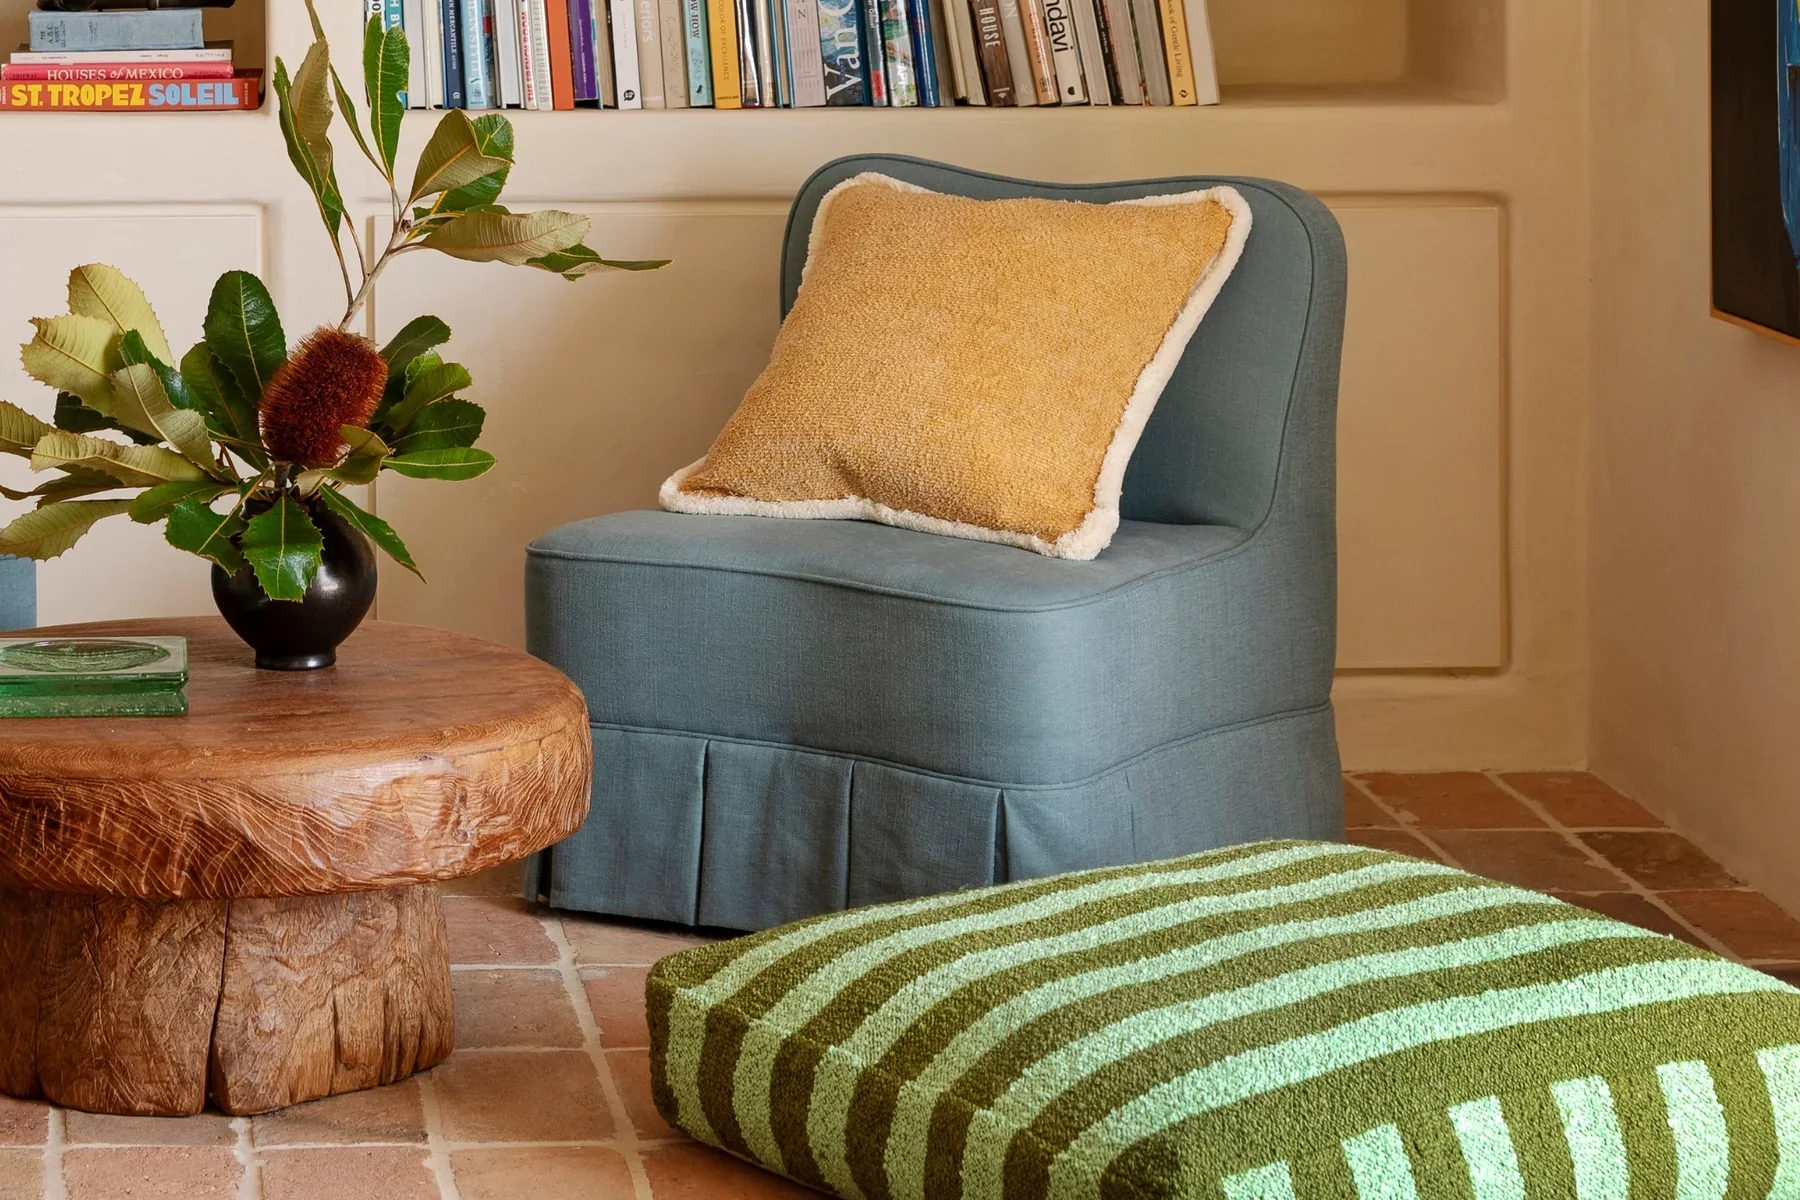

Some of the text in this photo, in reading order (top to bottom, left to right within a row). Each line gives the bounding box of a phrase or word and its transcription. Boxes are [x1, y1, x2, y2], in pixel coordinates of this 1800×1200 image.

[717, 0, 725, 23] COLOR
[1169, 15, 1177, 23] of
[978, 7, 1002, 48] HOUSE
[1170, 24, 1181, 50] Gentle
[719, 37, 730, 81] EXCELLENCE
[823, 23, 860, 99] Van
[1173, 52, 1184, 77] Living
[46, 69, 105, 80] HOUSES
[109, 66, 122, 78] of
[126, 68, 183, 78] MEXICO
[11, 83, 239, 106] ST. TROPEZ SOLEIL
